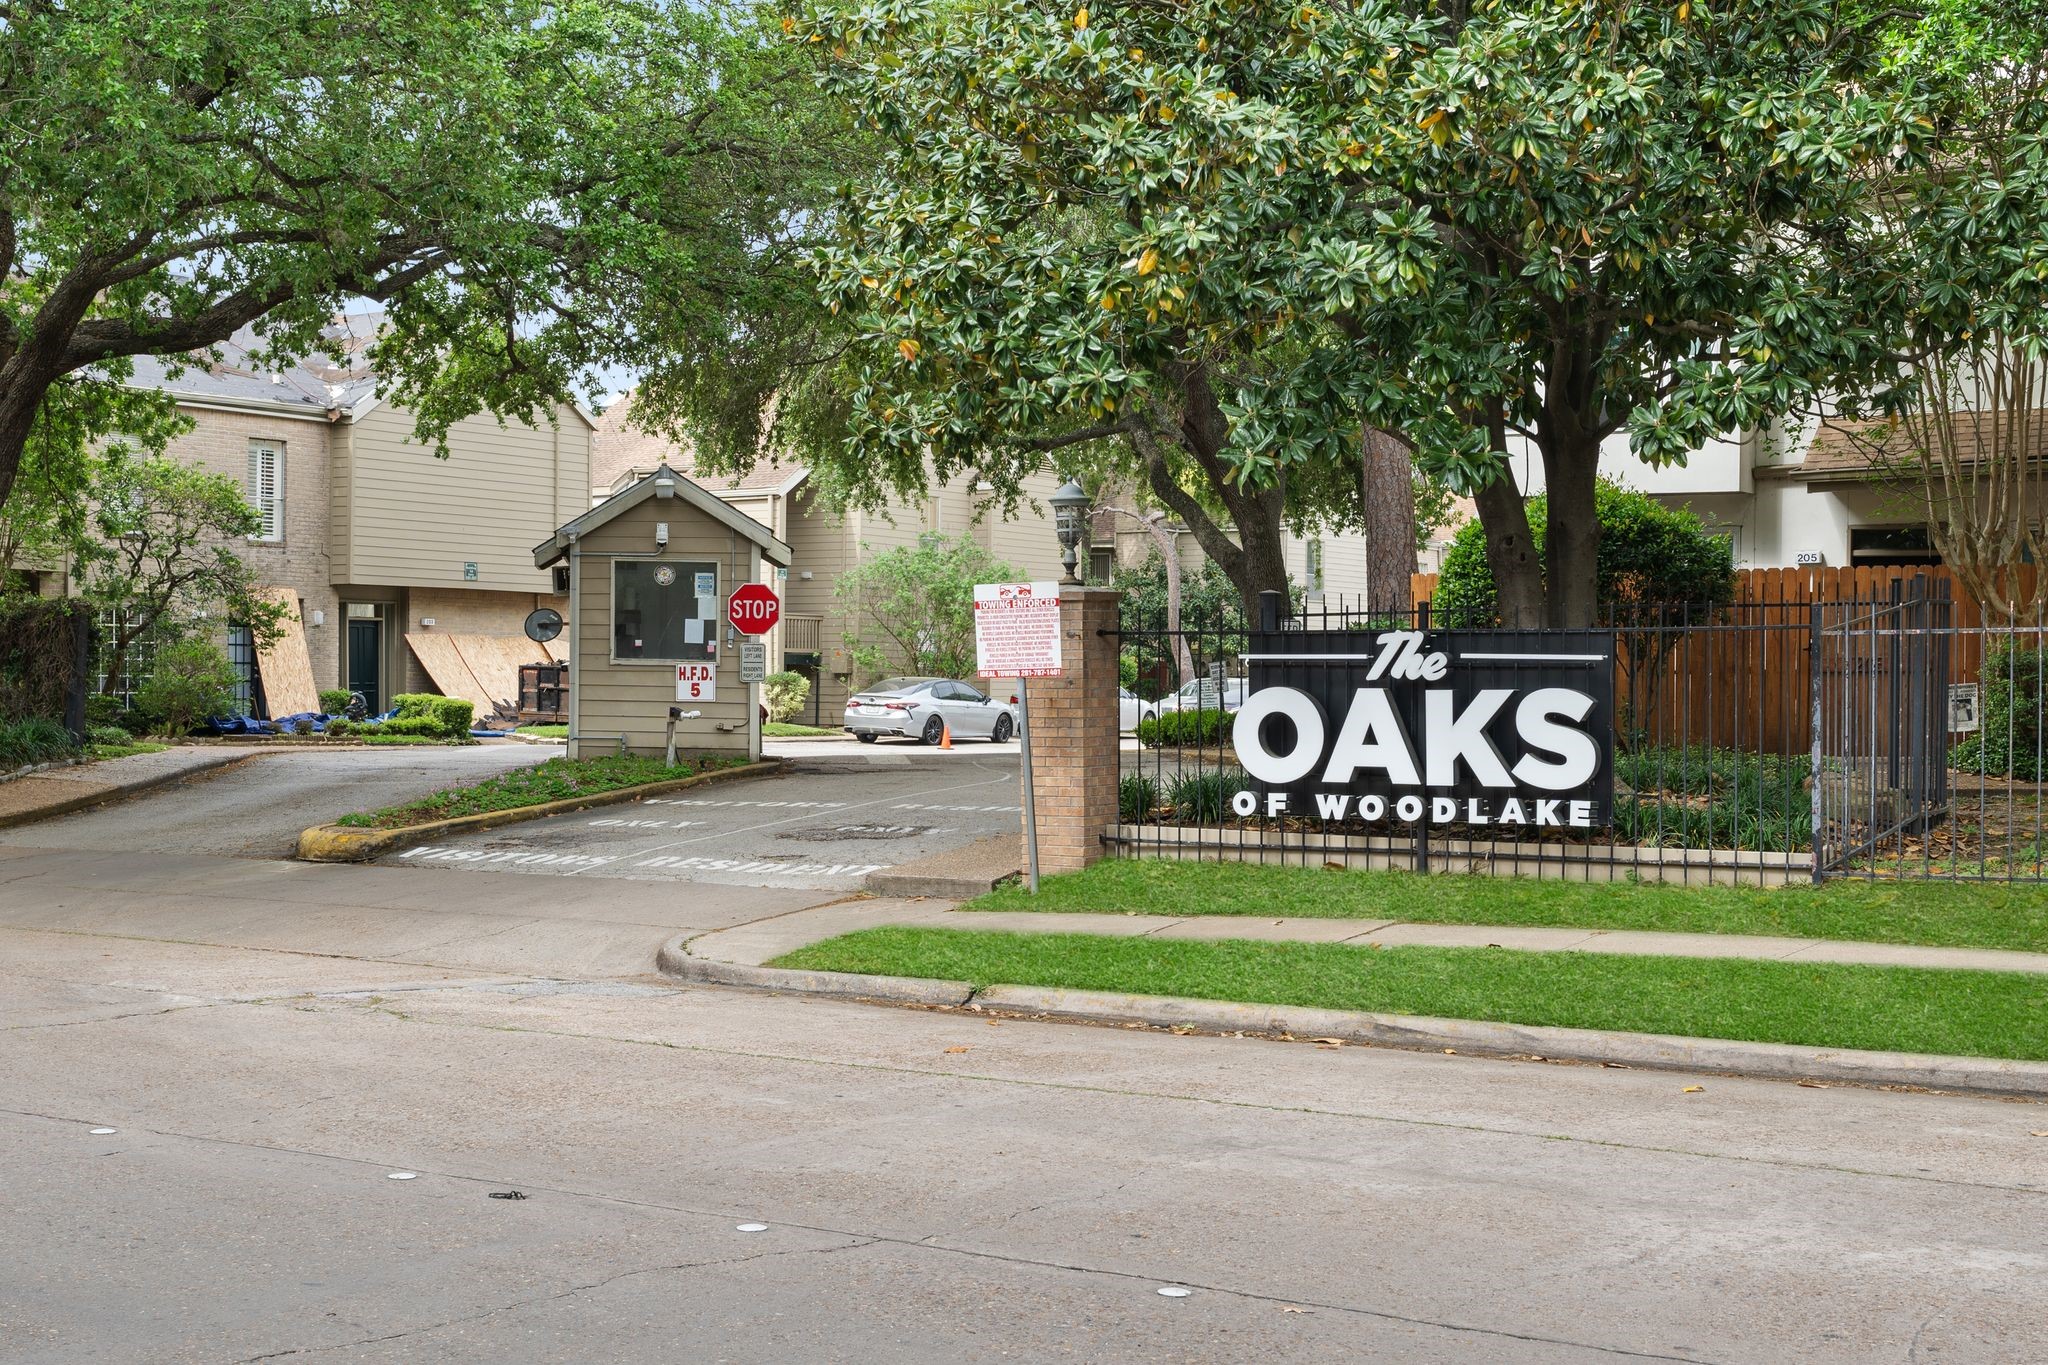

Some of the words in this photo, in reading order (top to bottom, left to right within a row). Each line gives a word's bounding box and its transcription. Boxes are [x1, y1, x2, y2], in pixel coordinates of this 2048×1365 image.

[1797, 553, 1818, 562] 205
[732, 599, 777, 619] STOP
[978, 601, 1011, 610] TOWING
[1013, 598, 1056, 609] ENFORCED
[1366, 629, 1448, 681] The
[678, 666, 713, 681] H.F.D.
[690, 682, 701, 697] 5
[1232, 686, 1599, 790] OAKS
[1232, 791, 1287, 818] OF
[1315, 794, 1591, 827] WOODLAKE
[588, 819, 707, 828] ONLY
[399, 847, 618, 865] VISITORS
[633, 856, 893, 876] RESIDENT
